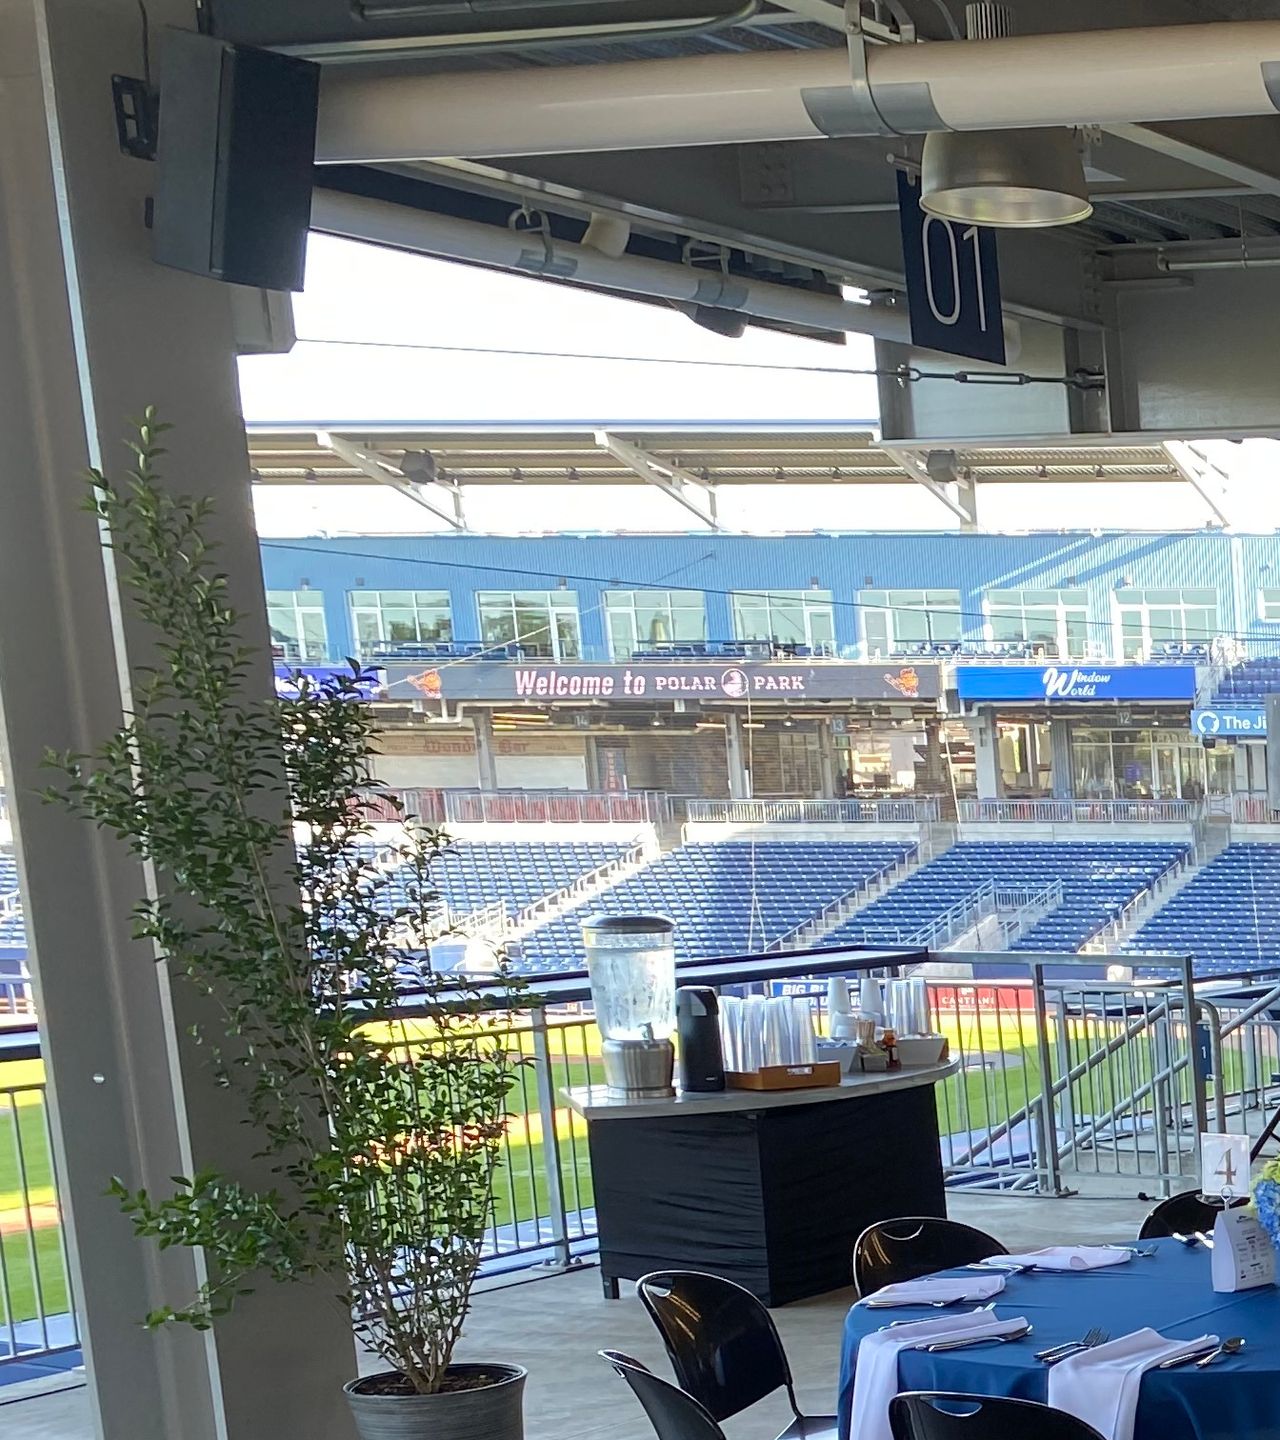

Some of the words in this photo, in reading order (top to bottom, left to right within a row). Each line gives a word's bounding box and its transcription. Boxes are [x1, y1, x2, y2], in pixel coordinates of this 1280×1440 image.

[922, 213, 986, 331] 01
[515, 670, 614, 696] Welcome
[624, 670, 646, 696] to
[655, 676, 717, 690] POLAR
[754, 675, 805, 690] PARK
[1118, 711, 1131, 725] 12
[1223, 716, 1250, 730] The
[424, 737, 475, 752] Wond
[1214, 1148, 1237, 1186] 4
